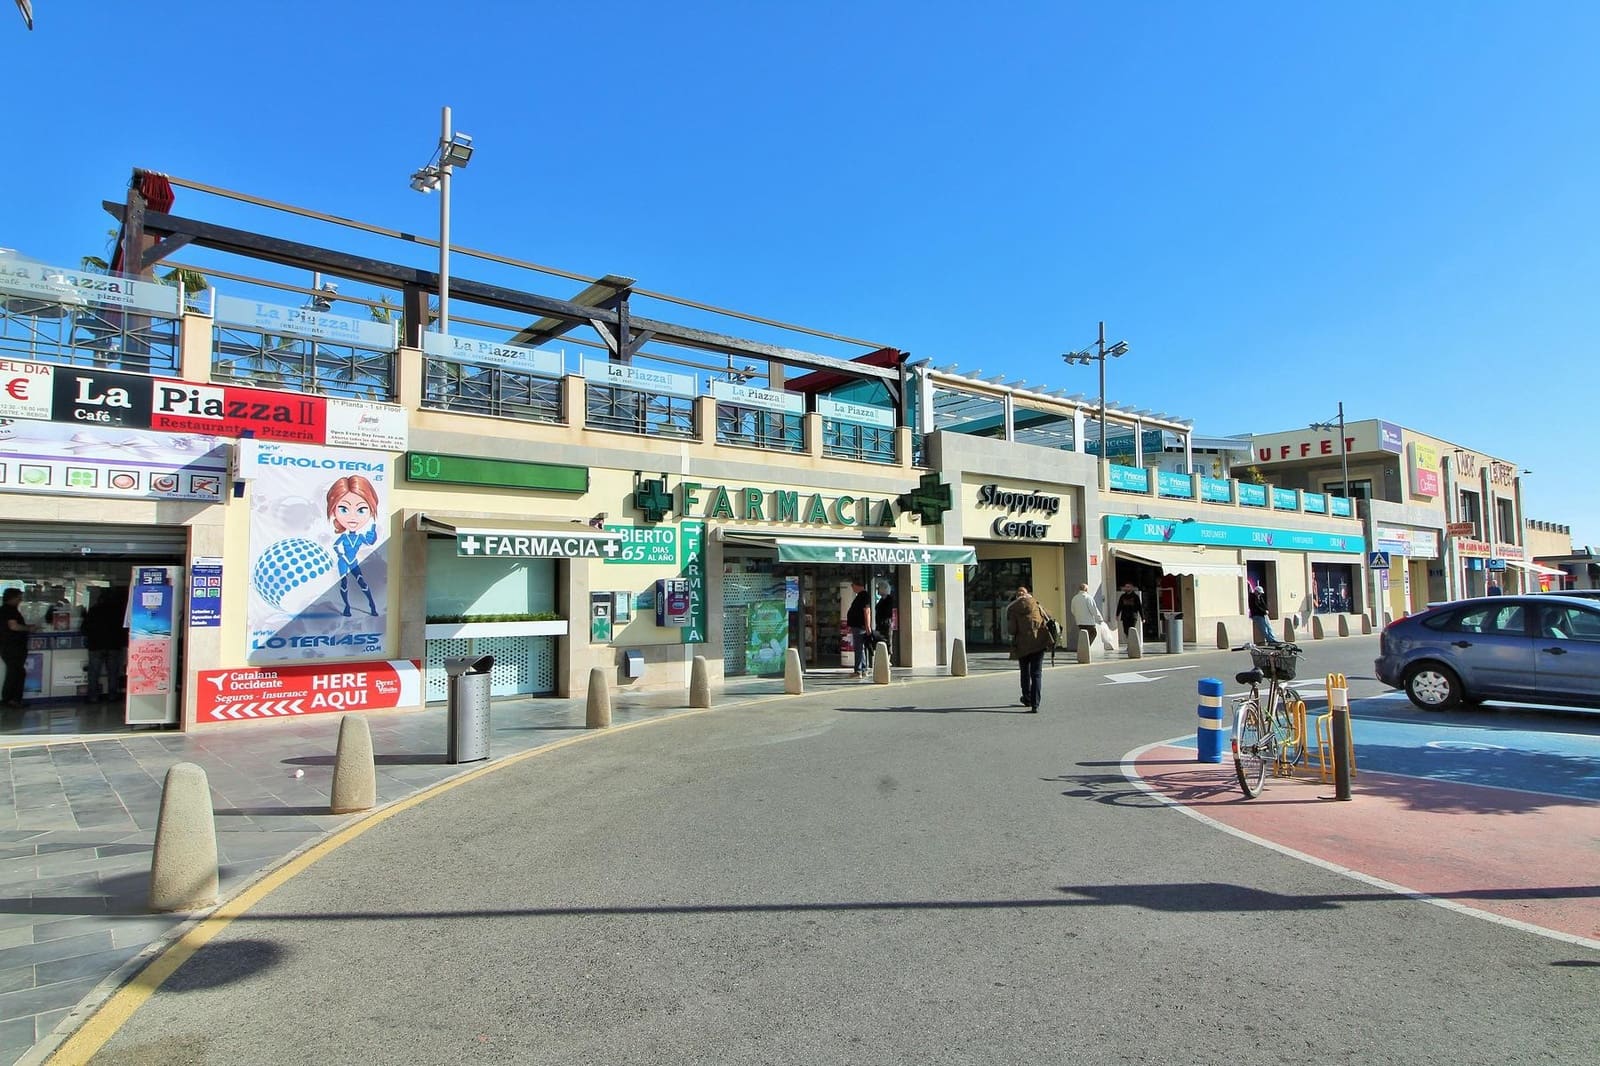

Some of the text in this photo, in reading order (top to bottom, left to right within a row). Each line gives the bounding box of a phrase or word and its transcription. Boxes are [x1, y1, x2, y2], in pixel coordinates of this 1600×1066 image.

[255, 303, 280, 319] La
[287, 308, 350, 332] Piazza
[453, 338, 473, 352] La
[478, 342, 526, 360] Piazza
[0, 362, 51, 376] EL DIA
[608, 365, 622, 377] La
[627, 368, 666, 385] Piazza
[75, 377, 315, 426] La Piazza II
[732, 385, 745, 398] La
[748, 386, 780, 403] Piazza
[834, 402, 845, 413] La
[847, 404, 875, 418] Piazza
[74, 409, 111, 422] Café
[262, 426, 314, 441] Pizzeria
[258, 452, 384, 473] EUROLOTERIA
[410, 454, 441, 478] 30
[682, 482, 896, 528] FARMACIA
[977, 484, 1061, 515] Shopping
[611, 527, 674, 544] BIERTO
[992, 516, 1052, 538] Center
[485, 536, 600, 557] FARMACIA
[620, 545, 669, 561] 65 DIAS
[852, 548, 916, 563] FARMACIA
[658, 552, 674, 562] AÑO
[688, 538, 701, 641] FARMACIA
[252, 632, 384, 650] LOTERIASS
[230, 671, 278, 680] Catalana
[230, 679, 283, 690] Occidente
[312, 672, 367, 690] HERE
[215, 693, 253, 705] Seguros
[262, 690, 308, 700] Insurance
[311, 690, 368, 710] AQUI
